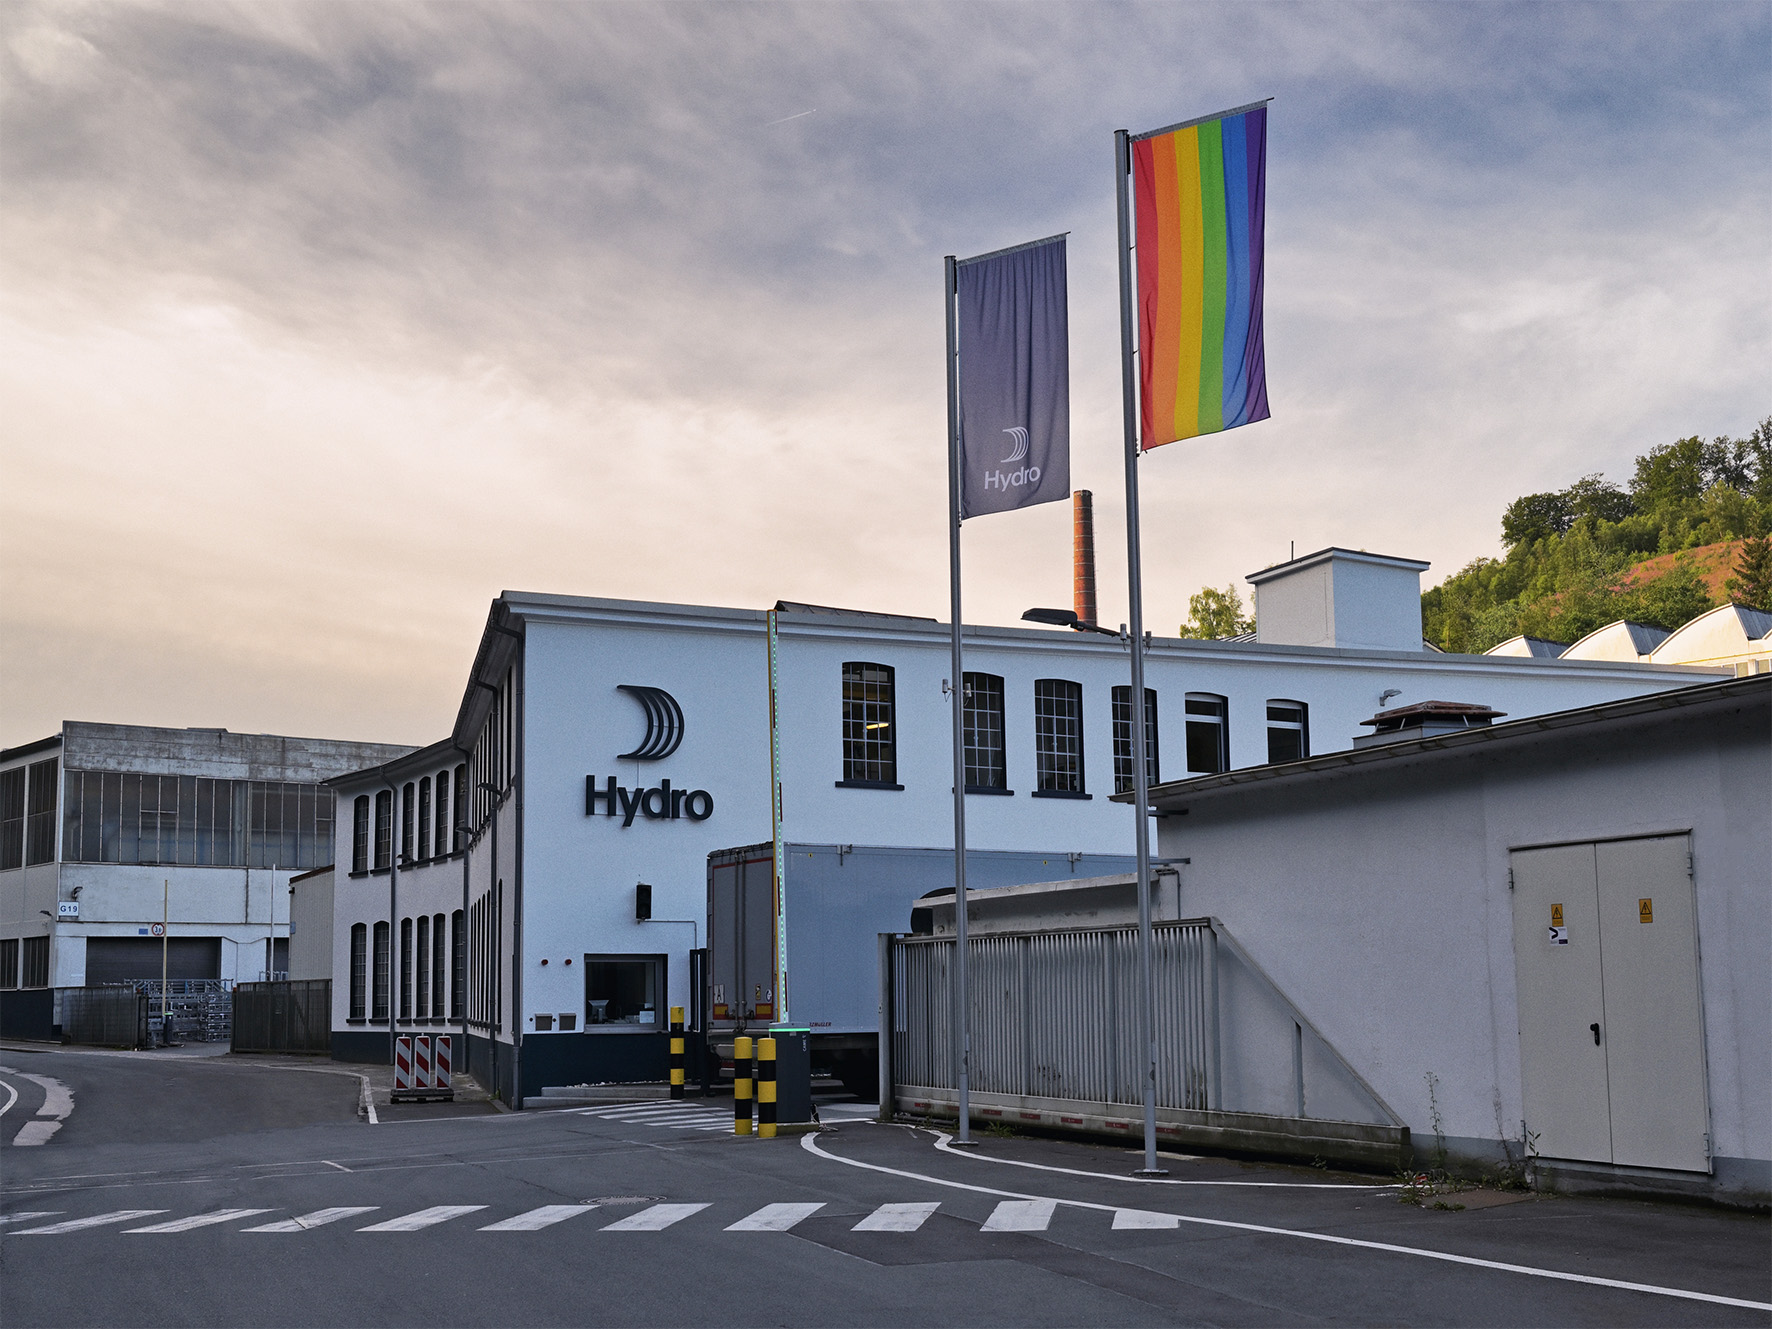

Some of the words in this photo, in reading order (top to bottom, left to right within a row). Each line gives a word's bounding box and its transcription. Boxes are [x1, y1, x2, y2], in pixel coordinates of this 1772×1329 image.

[984, 466, 1041, 492] Hydro
[586, 775, 714, 827] Hydro
[60, 905, 78, 913] G19
